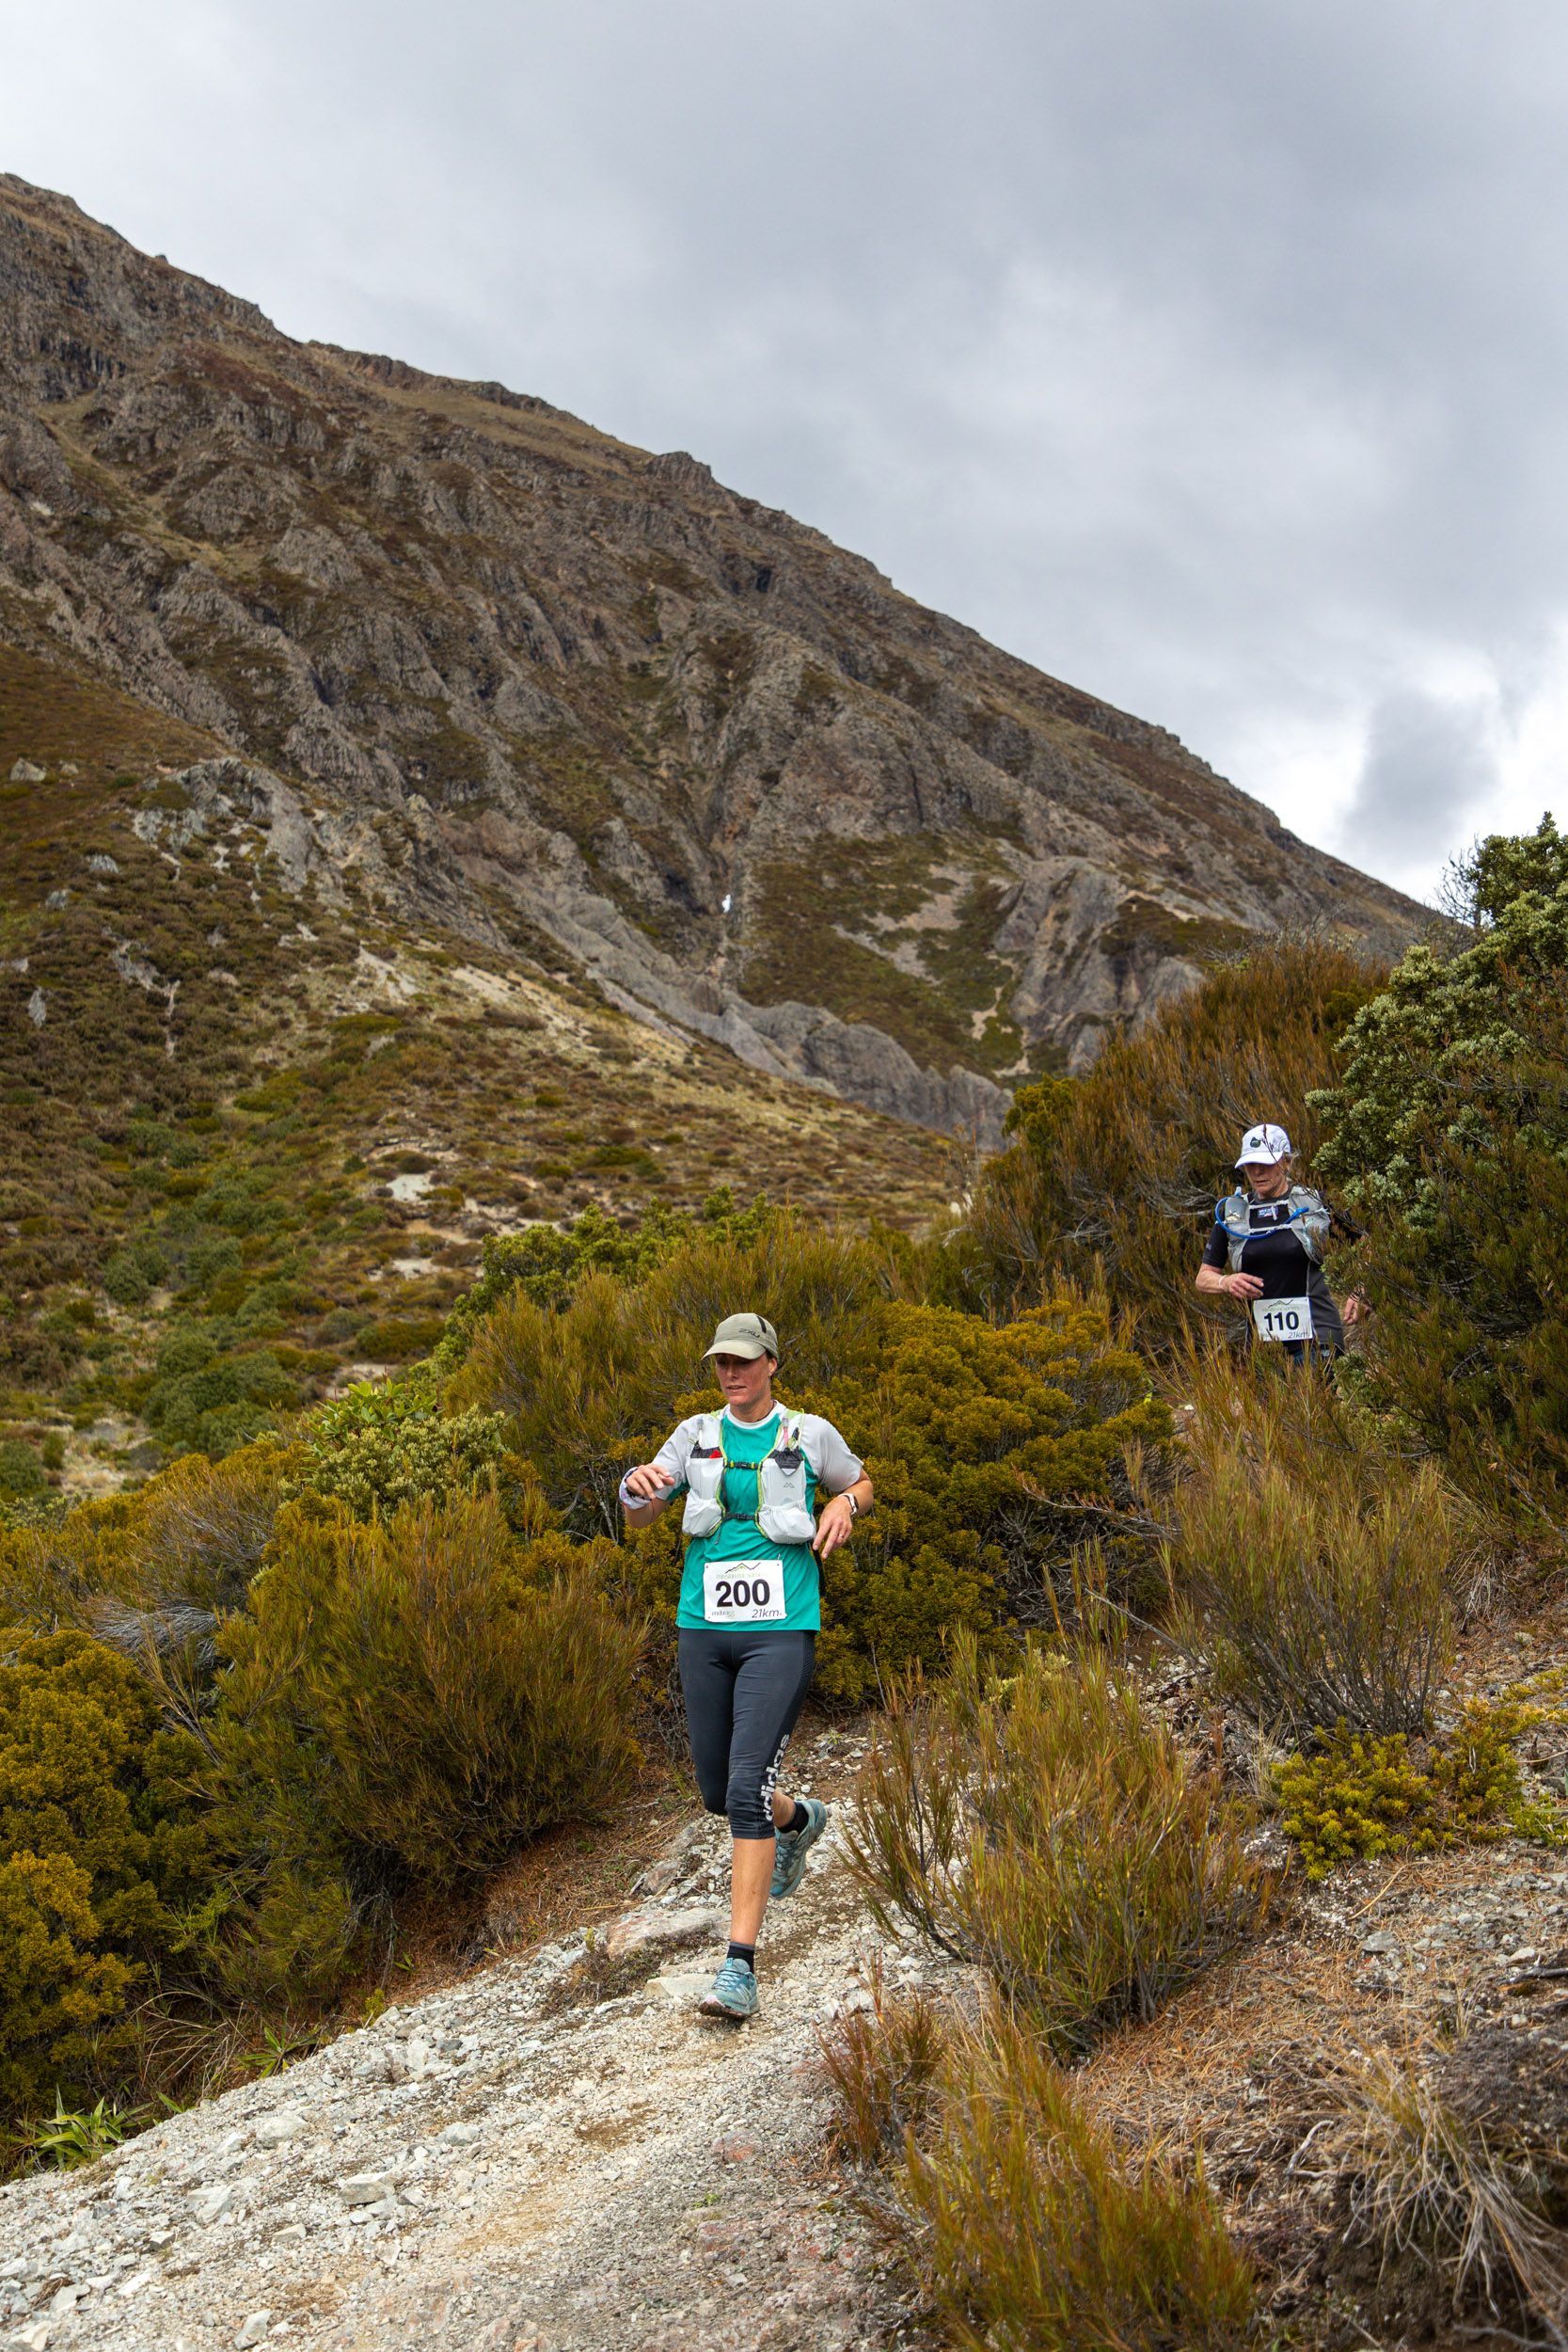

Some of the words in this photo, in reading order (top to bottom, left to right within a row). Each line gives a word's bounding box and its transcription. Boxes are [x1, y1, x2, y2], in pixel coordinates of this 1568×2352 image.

[1264, 1311, 1299, 1331] 110
[716, 1580, 770, 1607] 200
[752, 1609, 780, 1618] 21km
[760, 1734, 790, 1821] adidas
